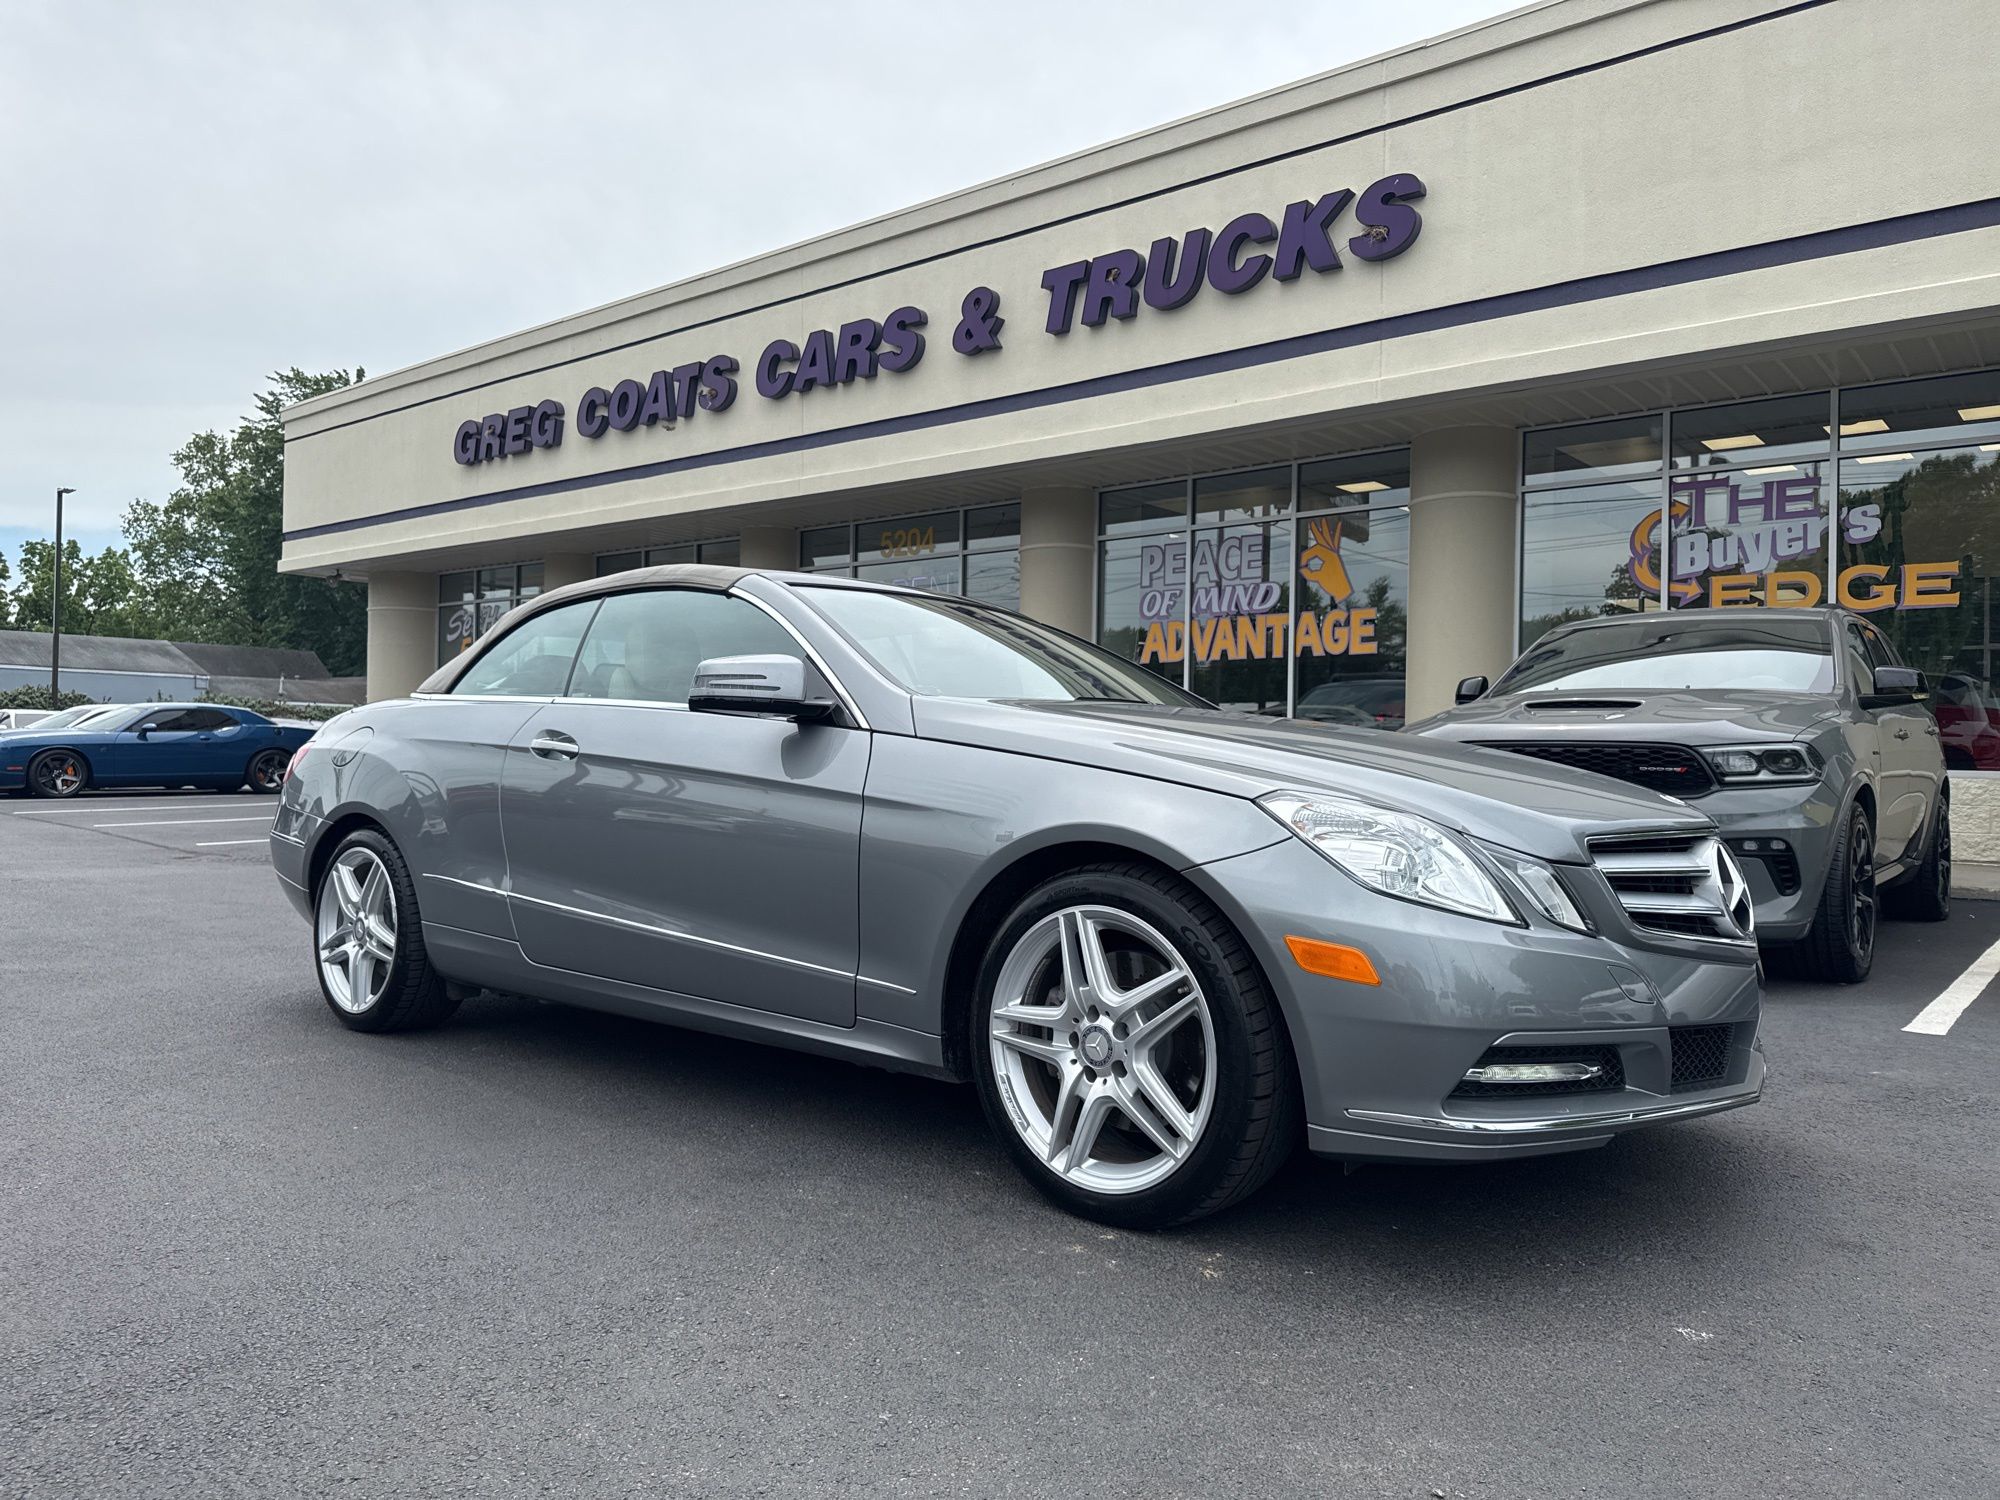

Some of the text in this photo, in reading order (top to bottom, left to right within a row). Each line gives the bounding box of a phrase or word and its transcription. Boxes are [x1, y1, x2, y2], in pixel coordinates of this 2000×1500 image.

[454, 173, 1427, 465] GREG COATS CARS & TRUCKS
[1671, 475, 1822, 528] THE
[880, 526, 936, 558] 5204
[1140, 534, 1264, 588] PEACE
[1673, 503, 1882, 575] Buyer's
[1140, 581, 1281, 619] OF MIND
[1708, 560, 1960, 613] EDGE
[1140, 607, 1378, 664] ADVANTAGE
